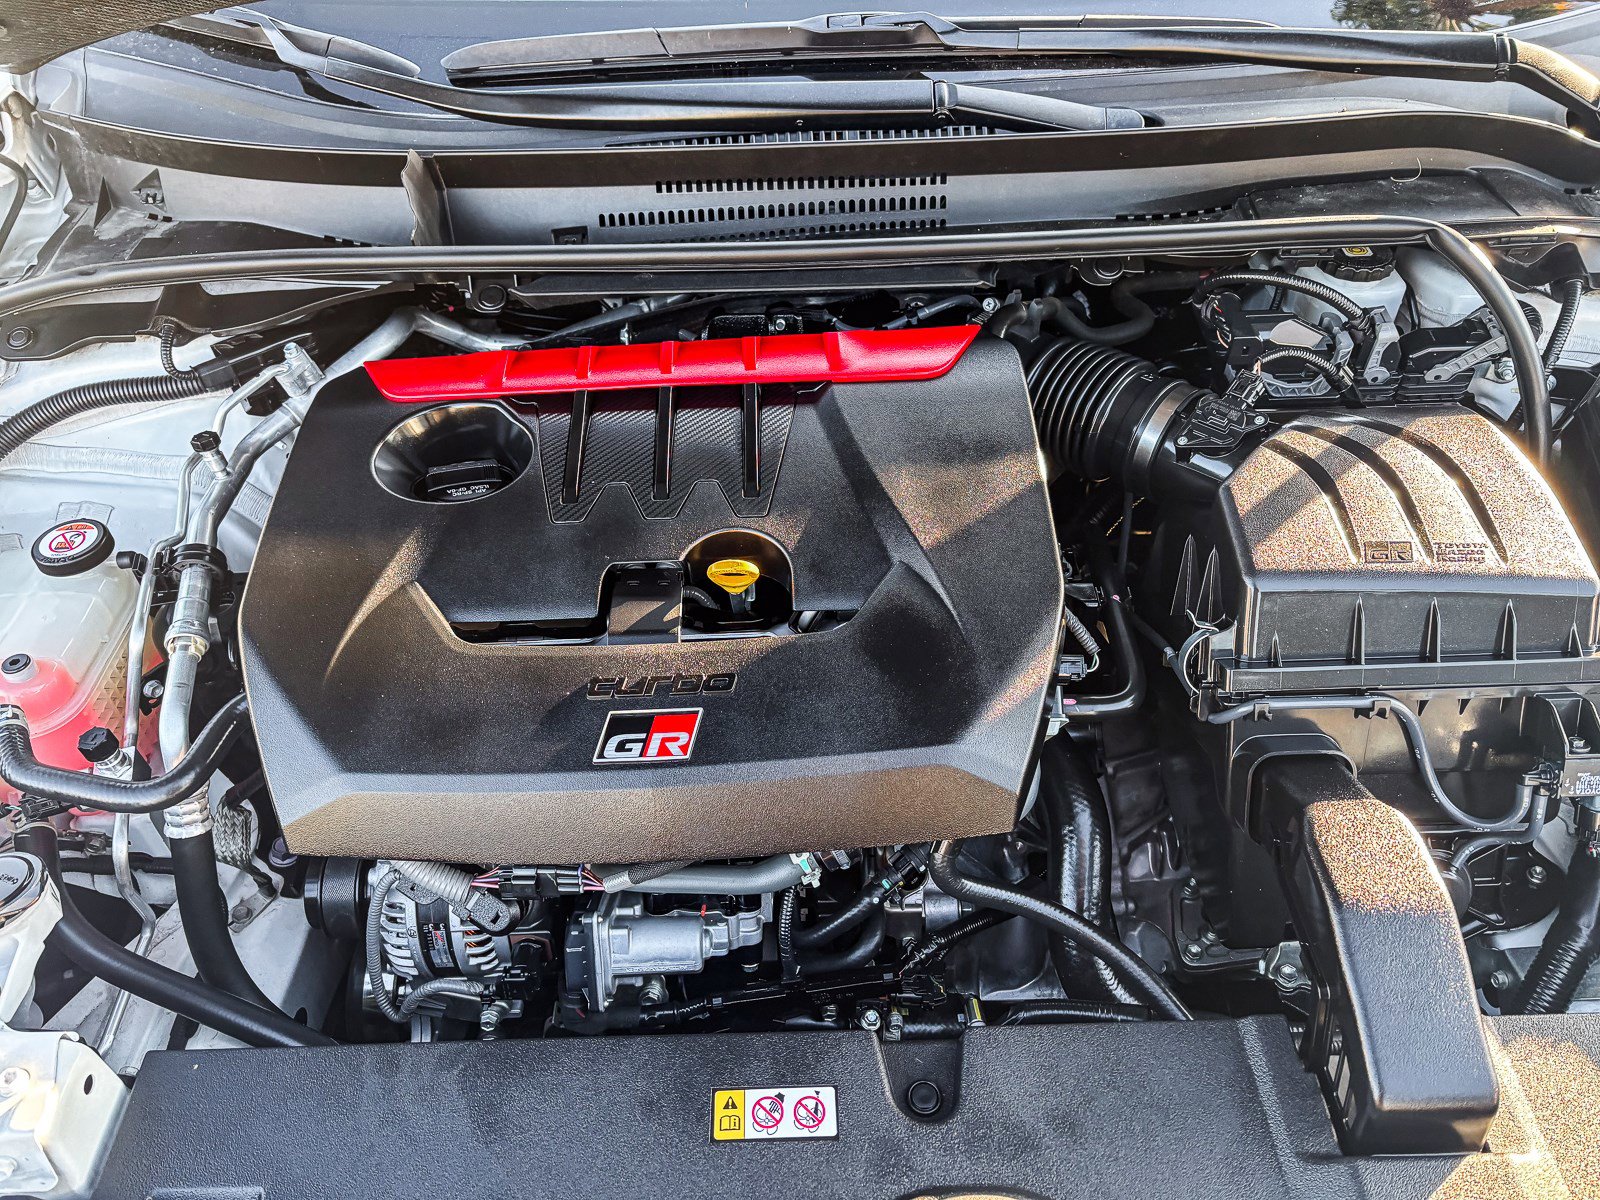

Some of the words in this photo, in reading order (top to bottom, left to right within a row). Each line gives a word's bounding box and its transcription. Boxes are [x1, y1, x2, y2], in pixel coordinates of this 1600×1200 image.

[1433, 542, 1488, 550] TOYOTA
[587, 673, 738, 700] turbo
[603, 731, 690, 758] GR
